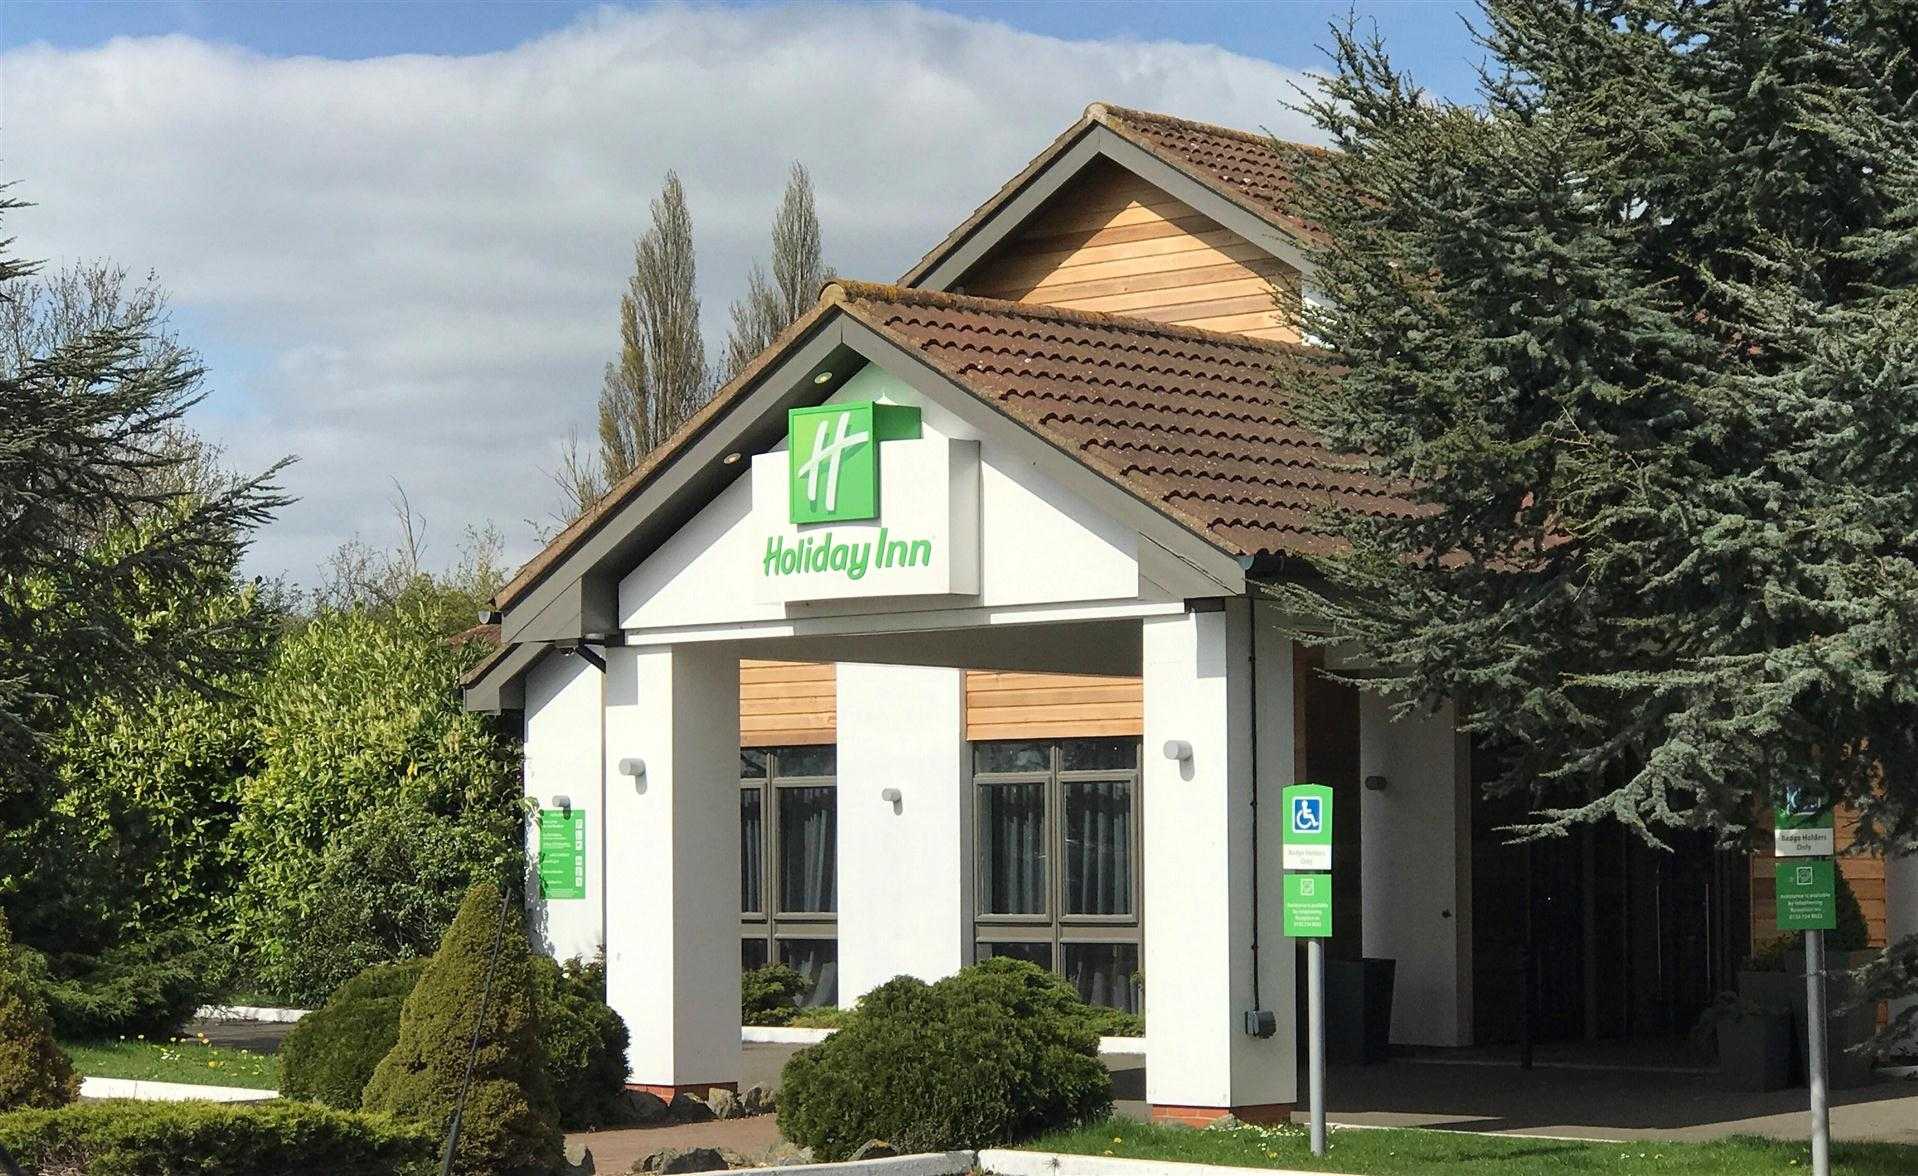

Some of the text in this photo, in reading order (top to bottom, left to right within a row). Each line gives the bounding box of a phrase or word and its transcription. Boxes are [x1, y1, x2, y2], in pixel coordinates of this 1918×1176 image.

[763, 528, 932, 580] Holiday Inn
[1802, 833, 1827, 841] Holders
